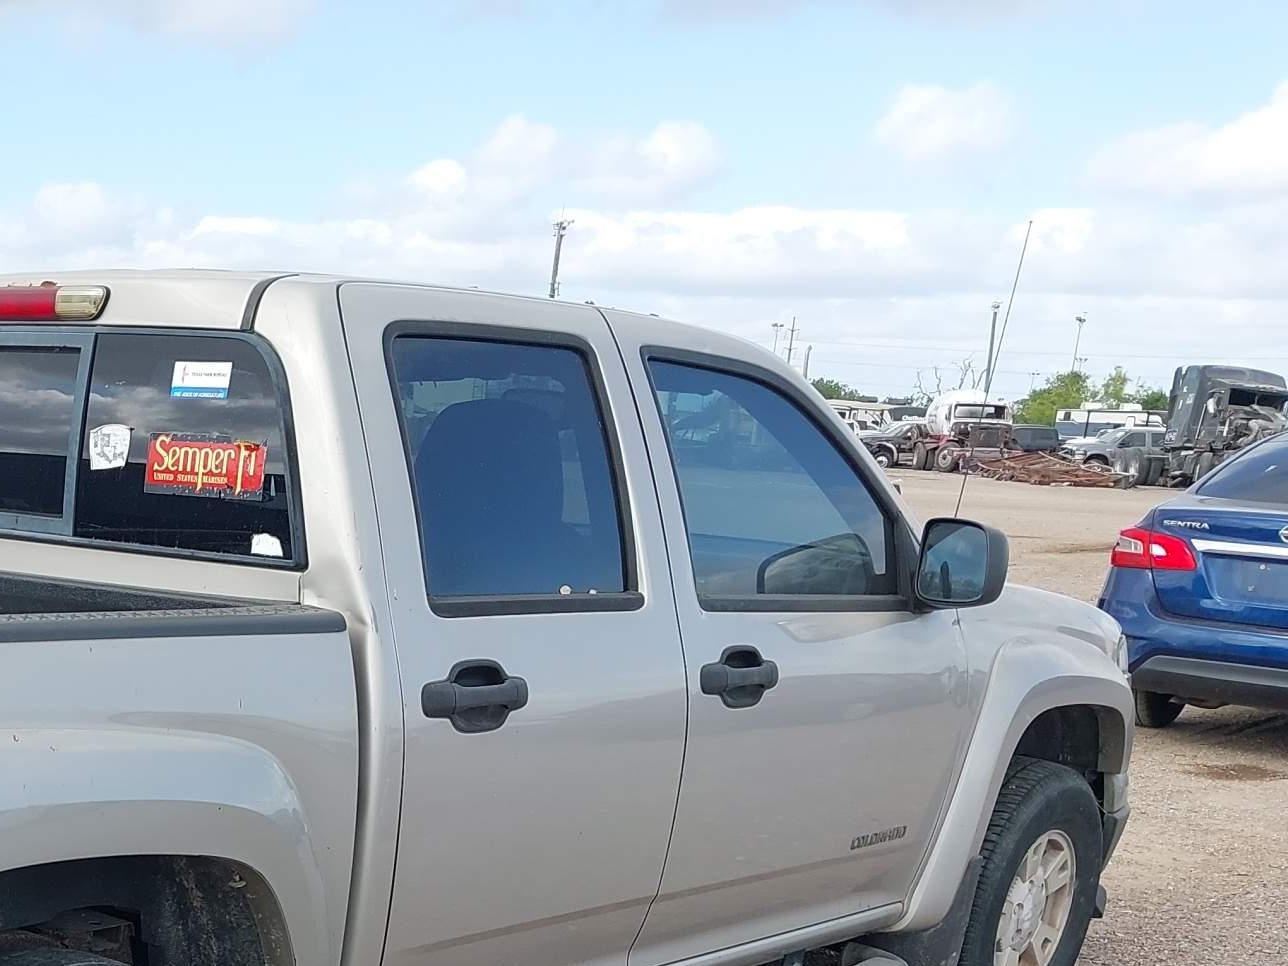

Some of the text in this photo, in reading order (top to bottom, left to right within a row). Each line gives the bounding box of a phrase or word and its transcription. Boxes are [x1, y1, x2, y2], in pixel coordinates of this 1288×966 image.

[153, 435, 235, 491] Semper
[154, 472, 174, 481] UNITED
[1163, 519, 1210, 530] SENTRA
